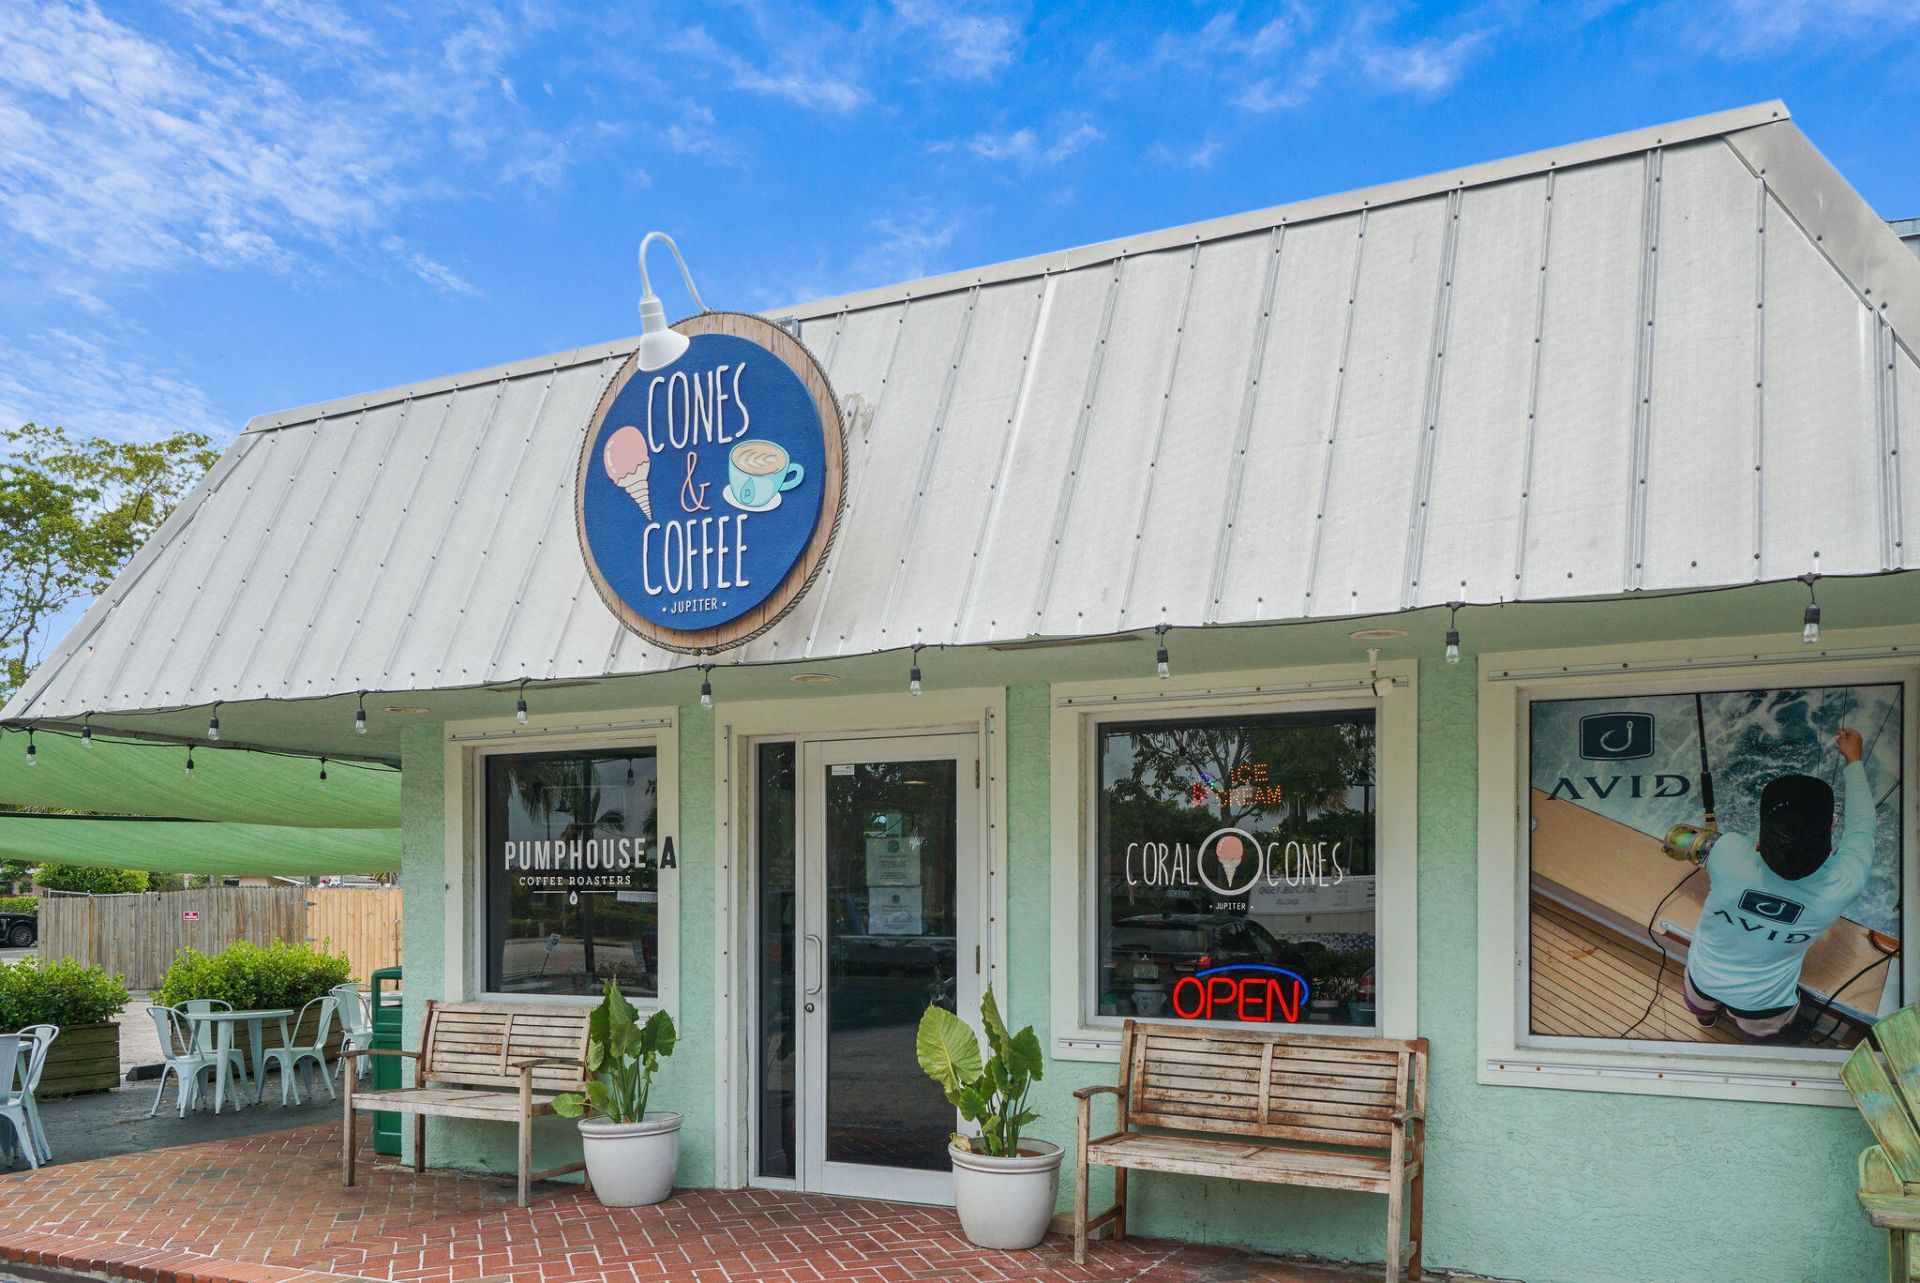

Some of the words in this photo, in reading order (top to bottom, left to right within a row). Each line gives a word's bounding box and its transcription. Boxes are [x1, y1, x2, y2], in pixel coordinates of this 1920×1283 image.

[648, 362, 749, 453] CONES
[681, 451, 711, 513] &
[643, 514, 749, 595] COFFEE
[671, 598, 718, 614] JUPITER
[1230, 763, 1269, 784] ICE
[1546, 774, 1691, 800] AVID
[1215, 784, 1282, 809] CREAM
[505, 838, 646, 870] PUMPHOUSE
[660, 836, 677, 869] A
[1126, 842, 1198, 886] CORAL
[1266, 841, 1343, 887] CONES
[519, 876, 563, 886] COFFEE
[569, 875, 631, 886] ROASTERS
[1215, 902, 1246, 911] JUPITER
[1712, 910, 1811, 944] AVID
[1173, 976, 1300, 1023] OPEN
